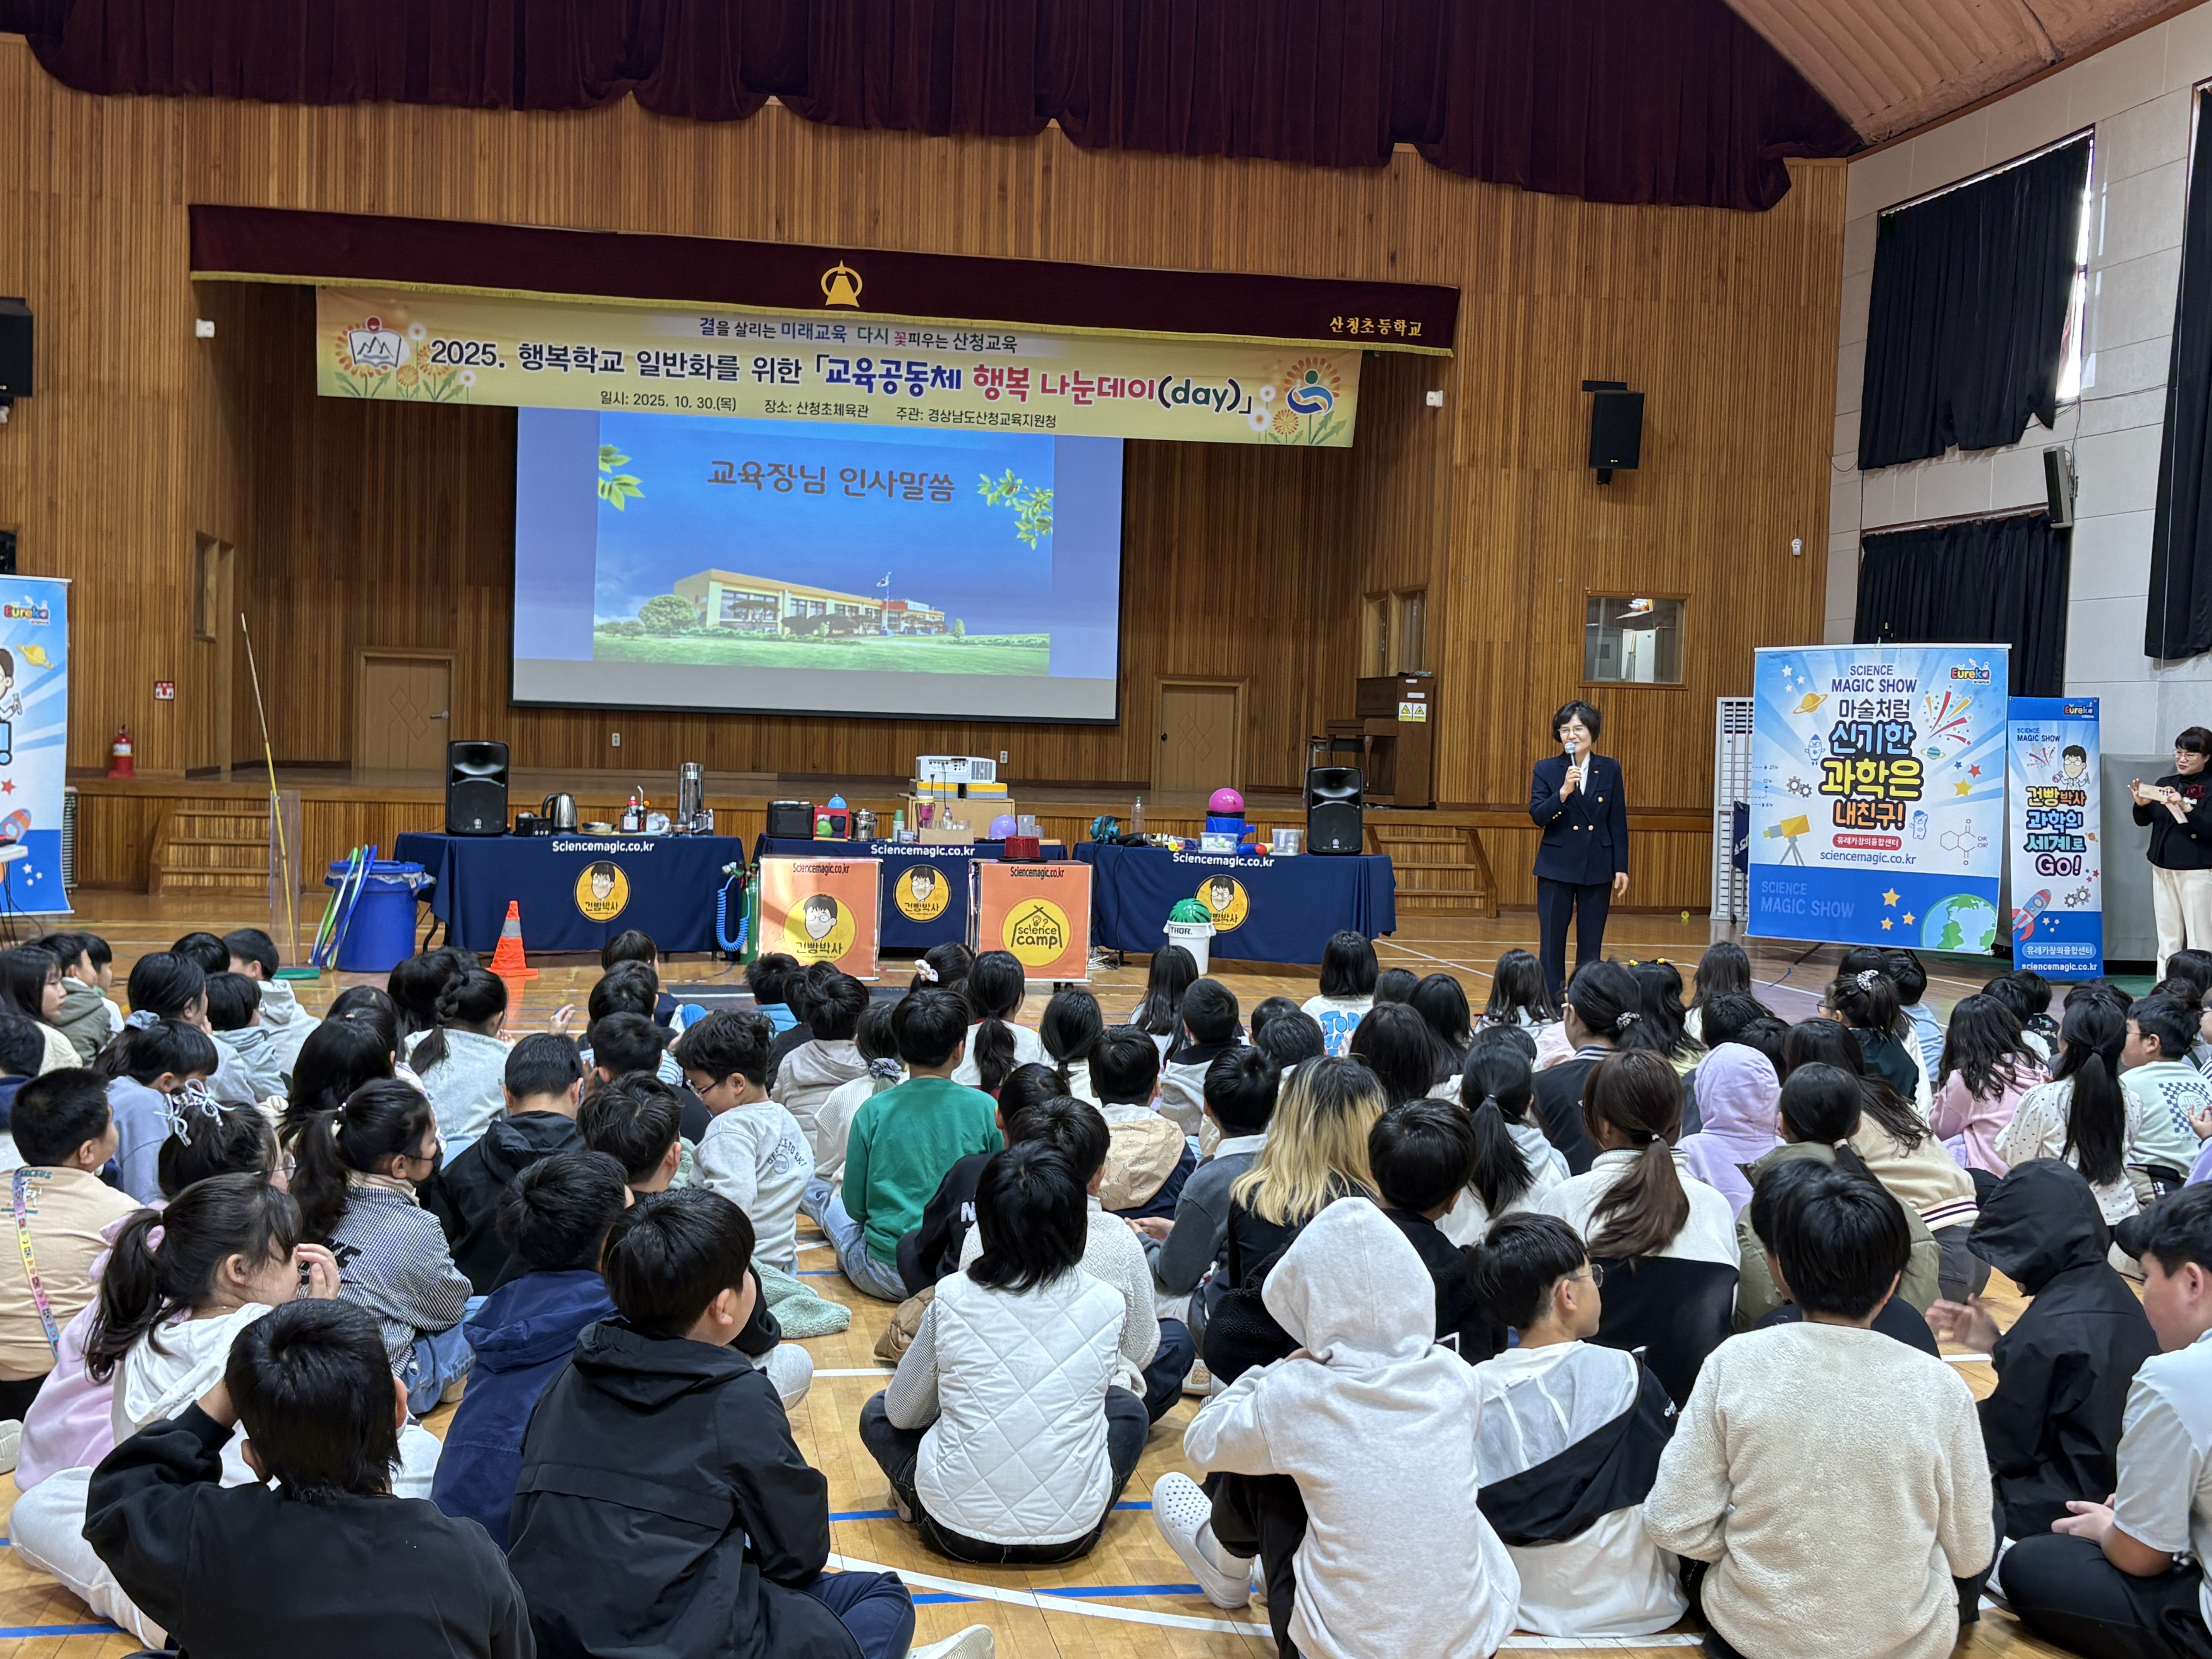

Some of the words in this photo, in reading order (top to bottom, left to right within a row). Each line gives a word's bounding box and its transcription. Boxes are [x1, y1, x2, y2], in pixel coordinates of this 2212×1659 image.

[1329, 316, 1422, 337] 산청초등학교
[699, 317, 730, 336] 결을
[734, 320, 776, 338] 살리는
[781, 322, 847, 343] 미래교육
[857, 326, 889, 345] 다시
[894, 331, 949, 349] 꽃피우는
[953, 333, 1018, 354] 산청교육
[431, 340, 505, 368] 2025.
[519, 343, 625, 374] 행복학교
[637, 350, 740, 381] 일반화를
[752, 356, 802, 384] 위한
[816, 354, 962, 397] 「교육공동체
[973, 364, 1030, 403] 행복
[600, 391, 629, 405] 일시:
[634, 393, 669, 407] 2025.
[675, 395, 692, 409] 10.
[697, 396, 737, 412] 30.(목)
[764, 399, 792, 414] 장소:
[796, 400, 869, 418] 산청초체육관
[896, 406, 923, 421] 주관:
[928, 409, 1056, 428] 경상남도산청교육지원청
[707, 460, 826, 495] 교육장님
[839, 467, 955, 503] 인사말씀
[1850, 665, 1894, 676] SCIENCE
[1950, 667, 1990, 680] Eureka
[1831, 678, 1874, 692] MAGIC
[1879, 679, 1917, 693] SHOW
[1839, 698, 1910, 719] 마술처럼
[1832, 722, 1914, 755] 신기한
[1821, 758, 1921, 799] 과학은
[2027, 787, 2086, 806] 건빵박사
[1836, 801, 1903, 827] 내친구!
[2028, 811, 2082, 833] 과학의
[552, 840, 655, 854] Sciencemagic.co.kr
[2026, 834, 2085, 851] 세계로
[871, 844, 975, 858] Sciencemagic.co.kr
[1820, 850, 1917, 865] sciencemagic.co.kr
[1173, 852, 1275, 868] Sciencemagic.co.kr
[793, 862, 850, 876] Sciencemagic.co.kr
[1010, 866, 1065, 879] Sciencemagic.co.kr
[1762, 881, 1807, 895] SCIENCE
[904, 903, 939, 912] 건빵박사
[1761, 896, 1806, 914] MAGIC
[1810, 900, 1855, 918] SHOW
[1211, 913, 1238, 923] 빵박사
[796, 942, 843, 955] 건빵박사
[1017, 935, 1058, 950] camp
[2021, 962, 2097, 972] sciencemagic.co.kr
